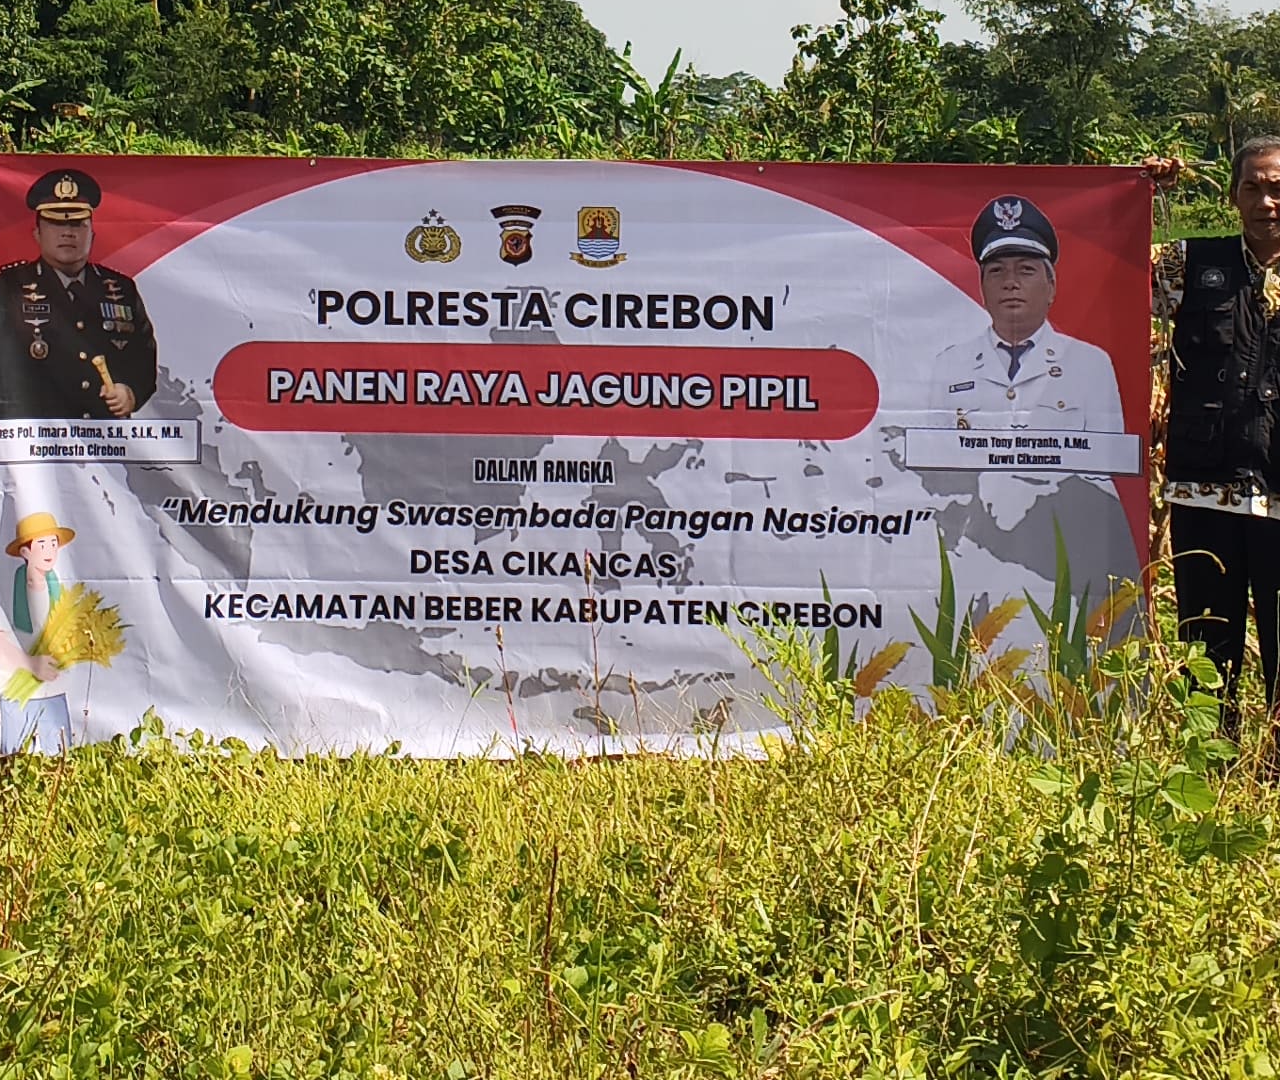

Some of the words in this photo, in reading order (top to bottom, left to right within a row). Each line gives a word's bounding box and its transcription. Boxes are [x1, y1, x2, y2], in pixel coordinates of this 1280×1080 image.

[317, 290, 553, 327] POLRESTA
[564, 293, 774, 331] CIREBON
[269, 369, 407, 404] PANEN
[416, 371, 530, 406] RAYA
[537, 372, 714, 408] JAGUNG
[721, 375, 819, 410] PIPIL
[38, 426, 67, 438] Imara
[70, 425, 105, 440] Utama,
[161, 427, 183, 439] M.H.
[959, 436, 989, 450] Yayan
[991, 436, 1013, 450] Tony
[30, 444, 85, 458] Kapolresta
[87, 444, 126, 457] Cirebon
[988, 454, 1015, 465] Kuwu
[1017, 454, 1062, 466] Cikancas
[474, 459, 537, 482] DALAM
[543, 461, 614, 484] RANGKA
[163, 498, 379, 534] “Mendukung
[387, 501, 616, 530] Swasembada
[624, 505, 754, 539] Pangan
[762, 506, 932, 536] Nasional”
[410, 550, 494, 576] DESA
[502, 551, 677, 579] CIKANCAS
[204, 594, 416, 620] KECAMATAN
[424, 596, 523, 622] BEBER
[531, 598, 728, 626] KABUPATEN
[736, 601, 882, 629] CIREBON
